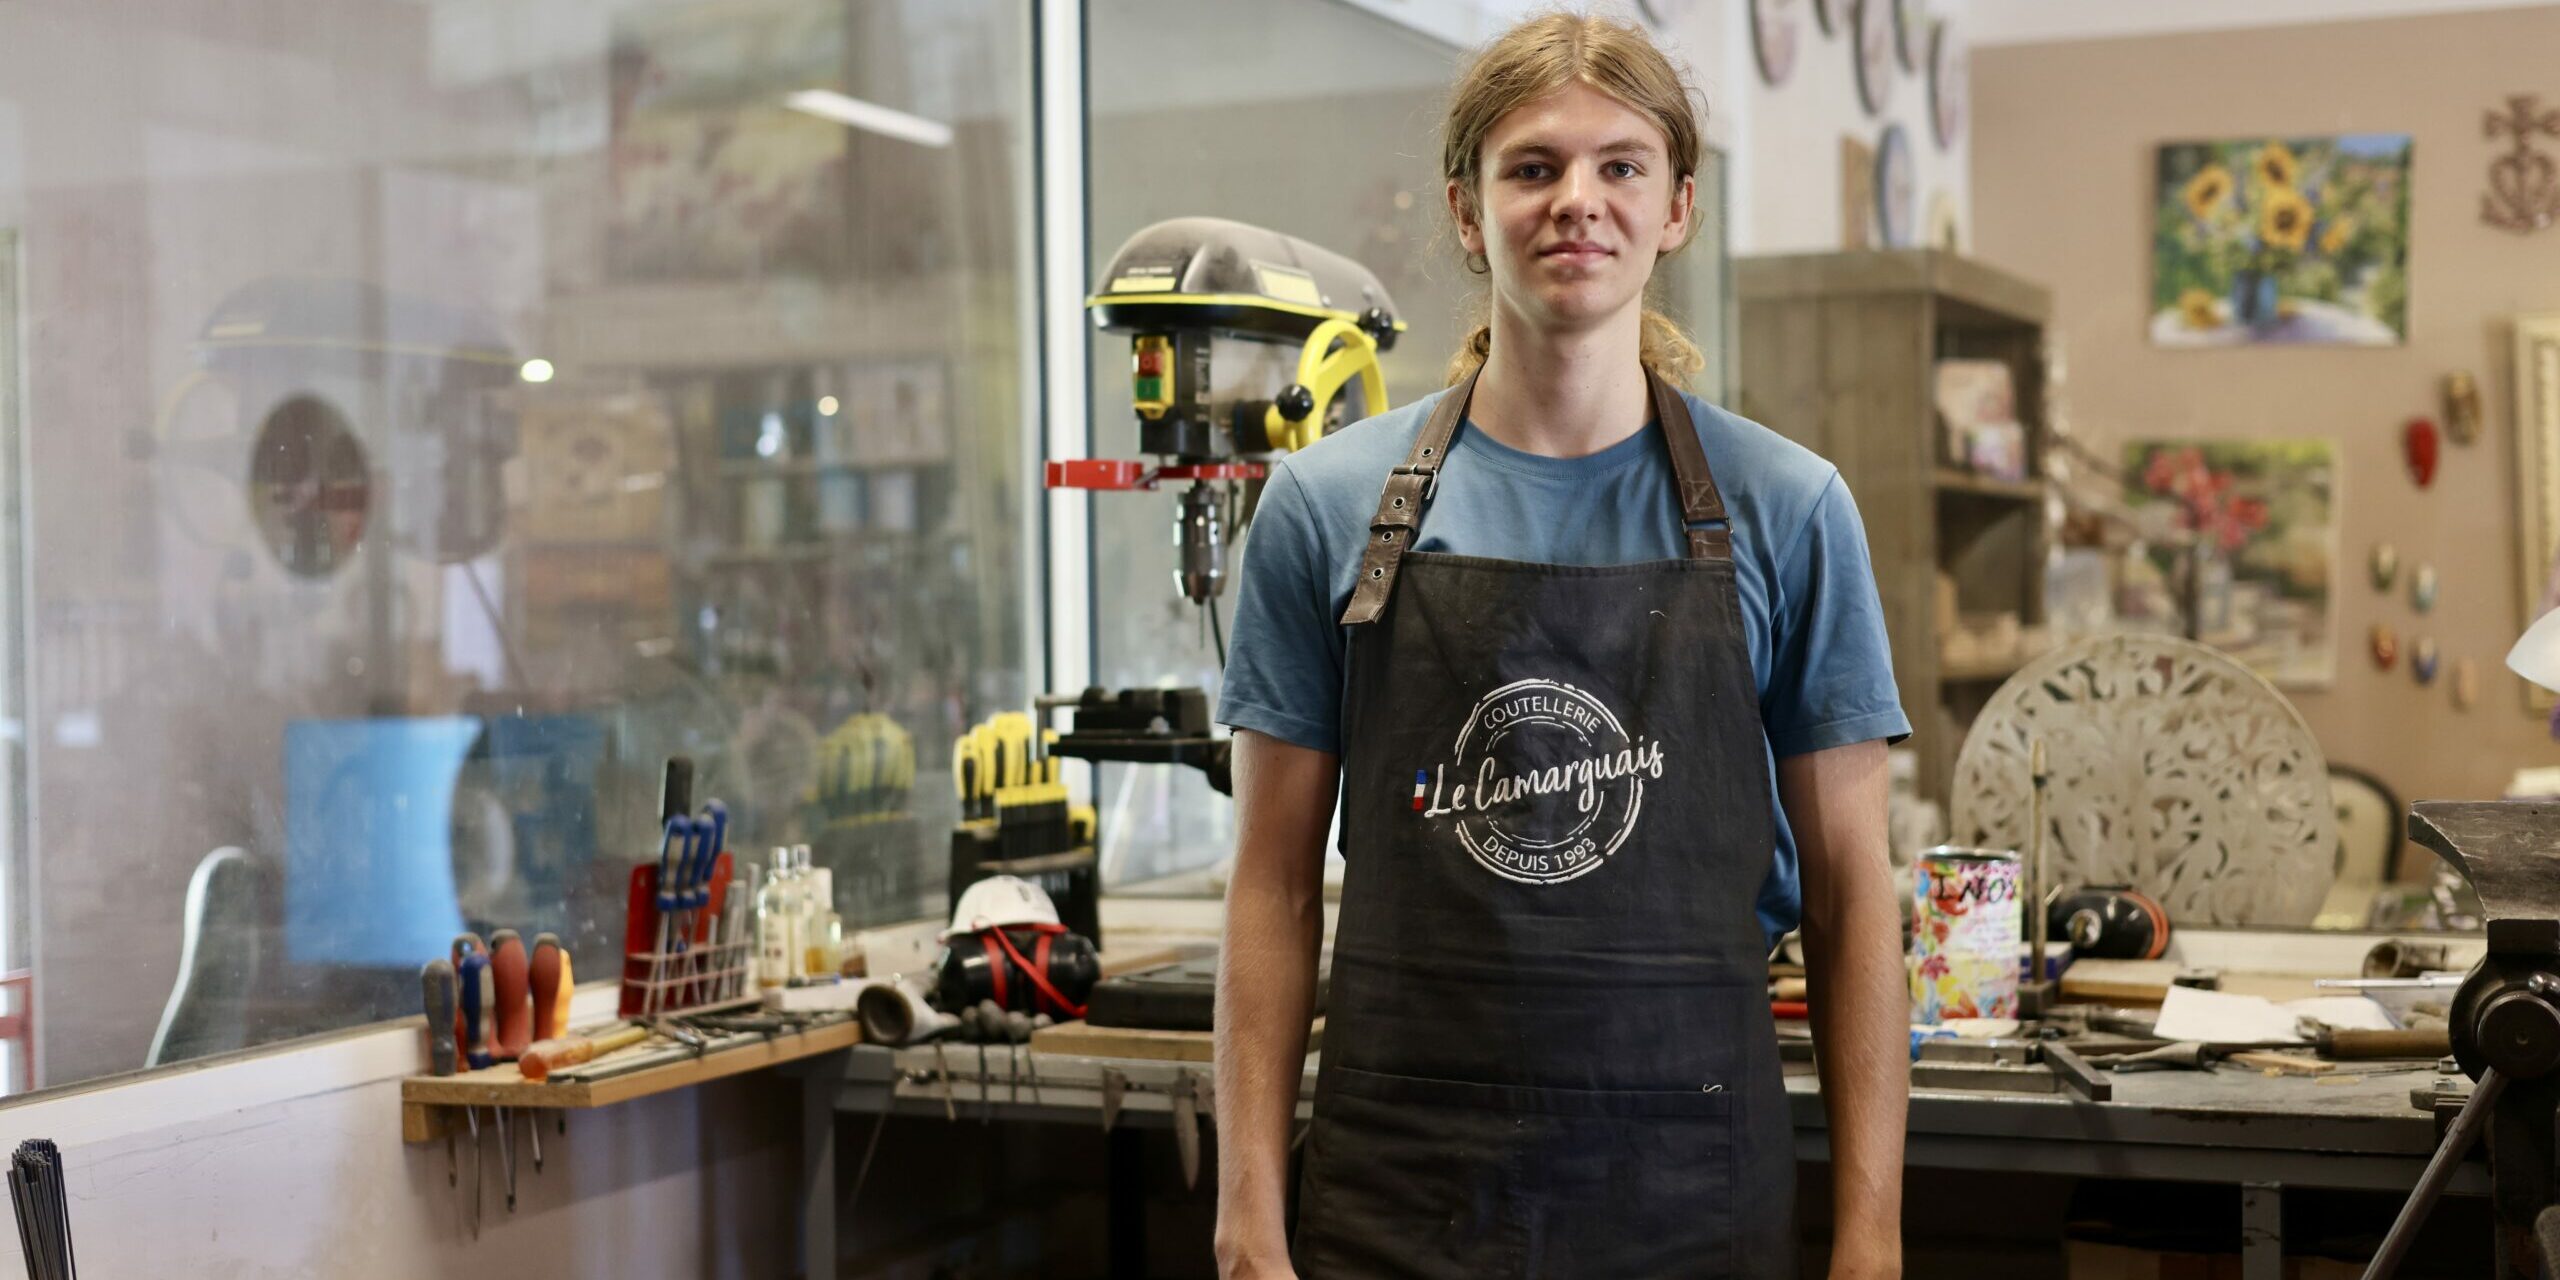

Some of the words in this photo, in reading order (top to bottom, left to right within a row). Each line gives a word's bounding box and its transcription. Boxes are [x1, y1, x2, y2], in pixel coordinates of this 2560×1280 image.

[1484, 695, 1602, 733] COUTELLERIE
[1424, 763, 1466, 818] Le
[1474, 735, 1664, 812] Camarguais
[1483, 835, 1549, 871] DEPUIS
[1554, 837, 1596, 870] 1993
